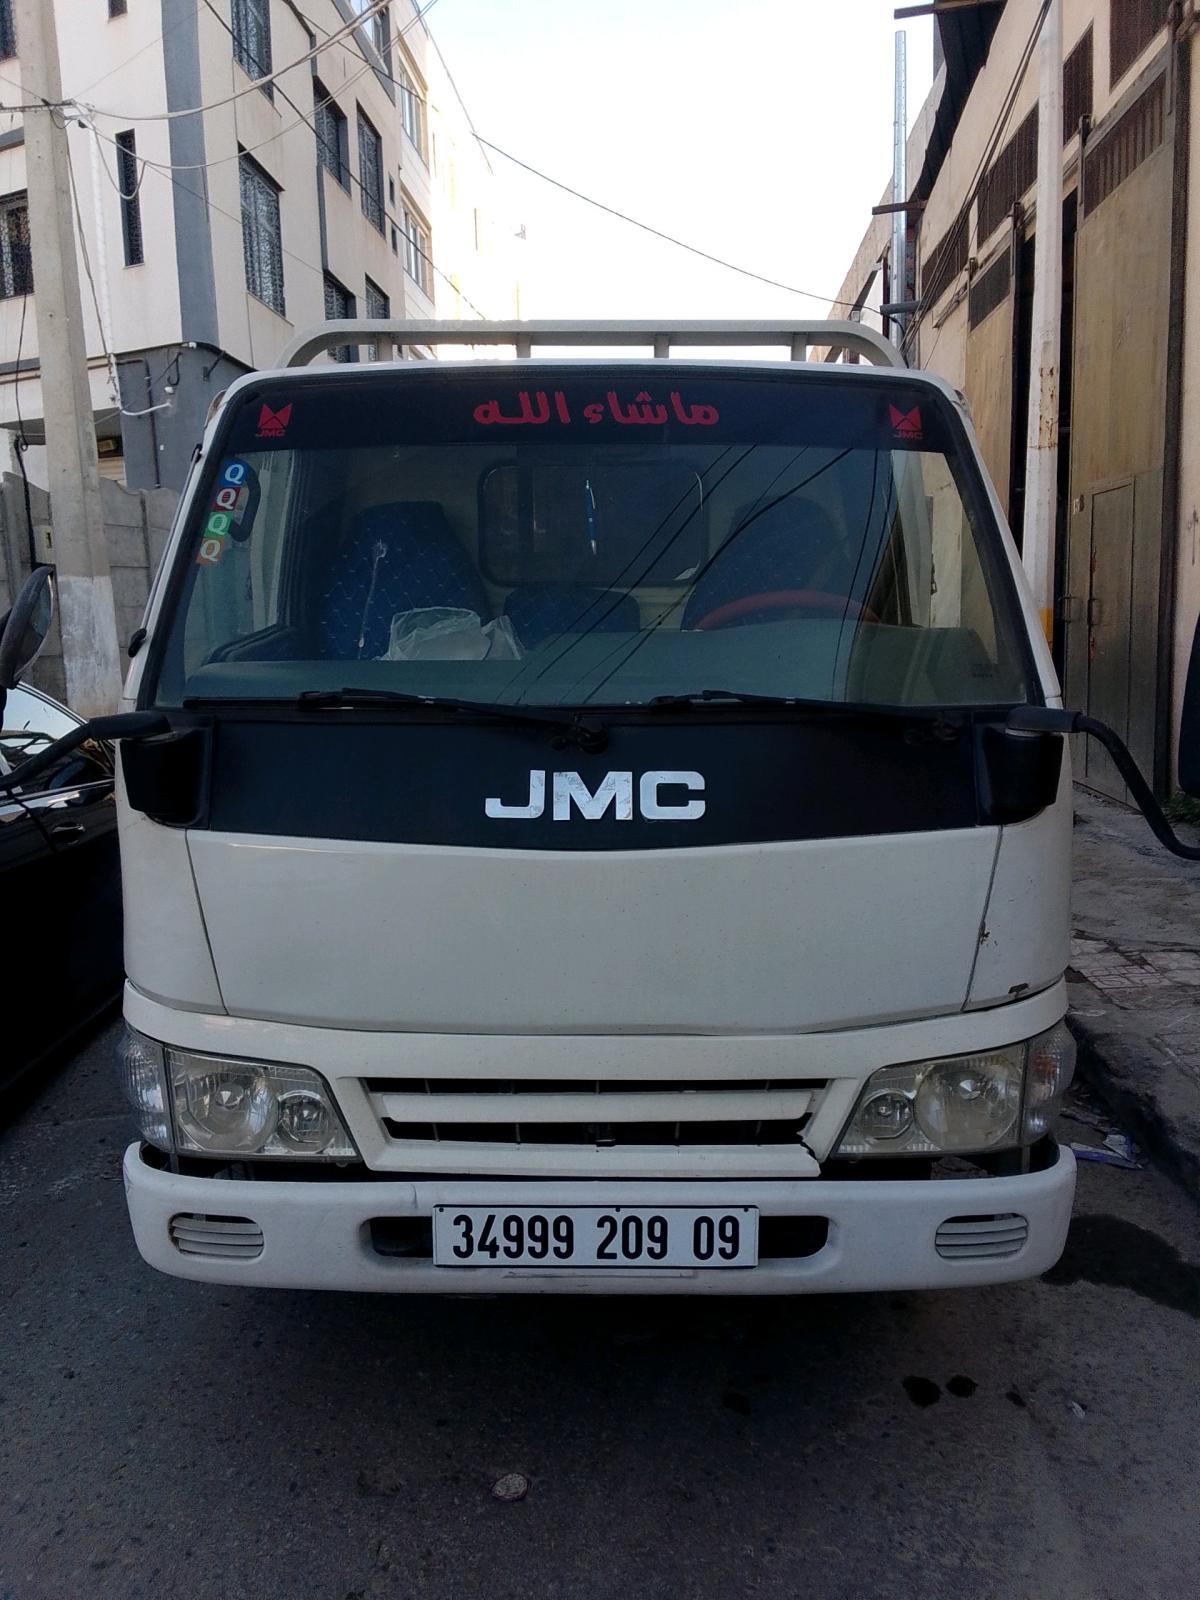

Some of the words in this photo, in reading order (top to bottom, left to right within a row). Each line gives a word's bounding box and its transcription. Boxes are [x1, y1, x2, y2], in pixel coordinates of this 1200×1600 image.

[473, 391, 571, 424] الله
[485, 769, 705, 821] JMC
[453, 1214, 574, 1259] 34999
[596, 1215, 668, 1260] 209
[693, 1215, 740, 1260] 09
